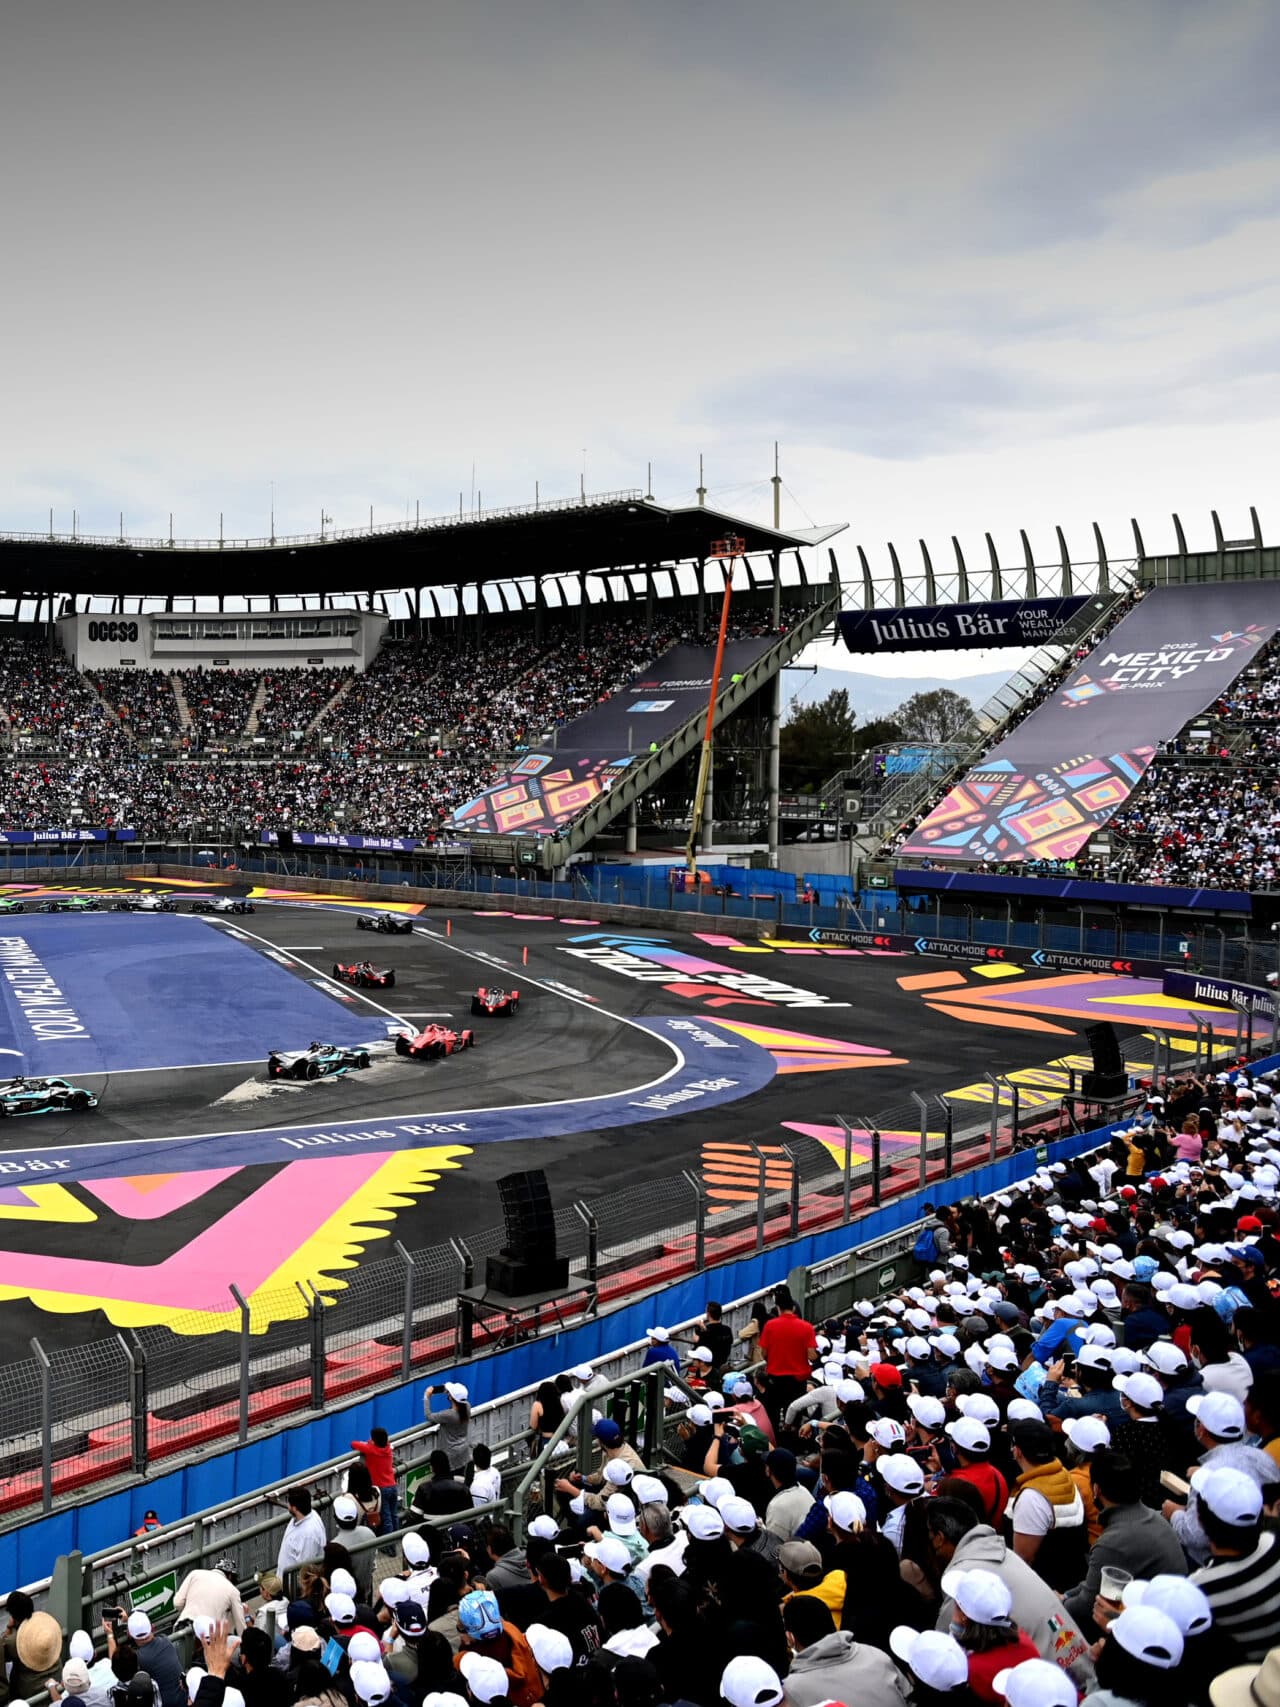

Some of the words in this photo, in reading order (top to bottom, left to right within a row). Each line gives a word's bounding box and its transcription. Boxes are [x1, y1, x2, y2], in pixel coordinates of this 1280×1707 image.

[1017, 609, 1049, 620] YOUR
[870, 618, 950, 646] Julius
[954, 613, 1008, 637] Bär
[1020, 618, 1065, 629] WEALTH
[1100, 648, 1234, 666] MEXICO
[1111, 665, 1198, 682] CITY
[1120, 682, 1166, 690] E-PRIX
[846, 799, 859, 813] D
[34, 831, 58, 841] Julius
[59, 831, 77, 840] Bär
[821, 932, 850, 943] ATTACK
[851, 934, 873, 944] MODE
[928, 942, 959, 953] ATTACK
[961, 945, 986, 956] MODE
[1046, 954, 1081, 966] ATTACK
[1084, 958, 1111, 969] MODE
[3, 968, 67, 1007] WEALTH
[1195, 982, 1229, 1001] Julius
[24, 1008, 91, 1041] YOUR
[278, 1125, 397, 1149] Julius
[403, 1119, 473, 1135] Bär
